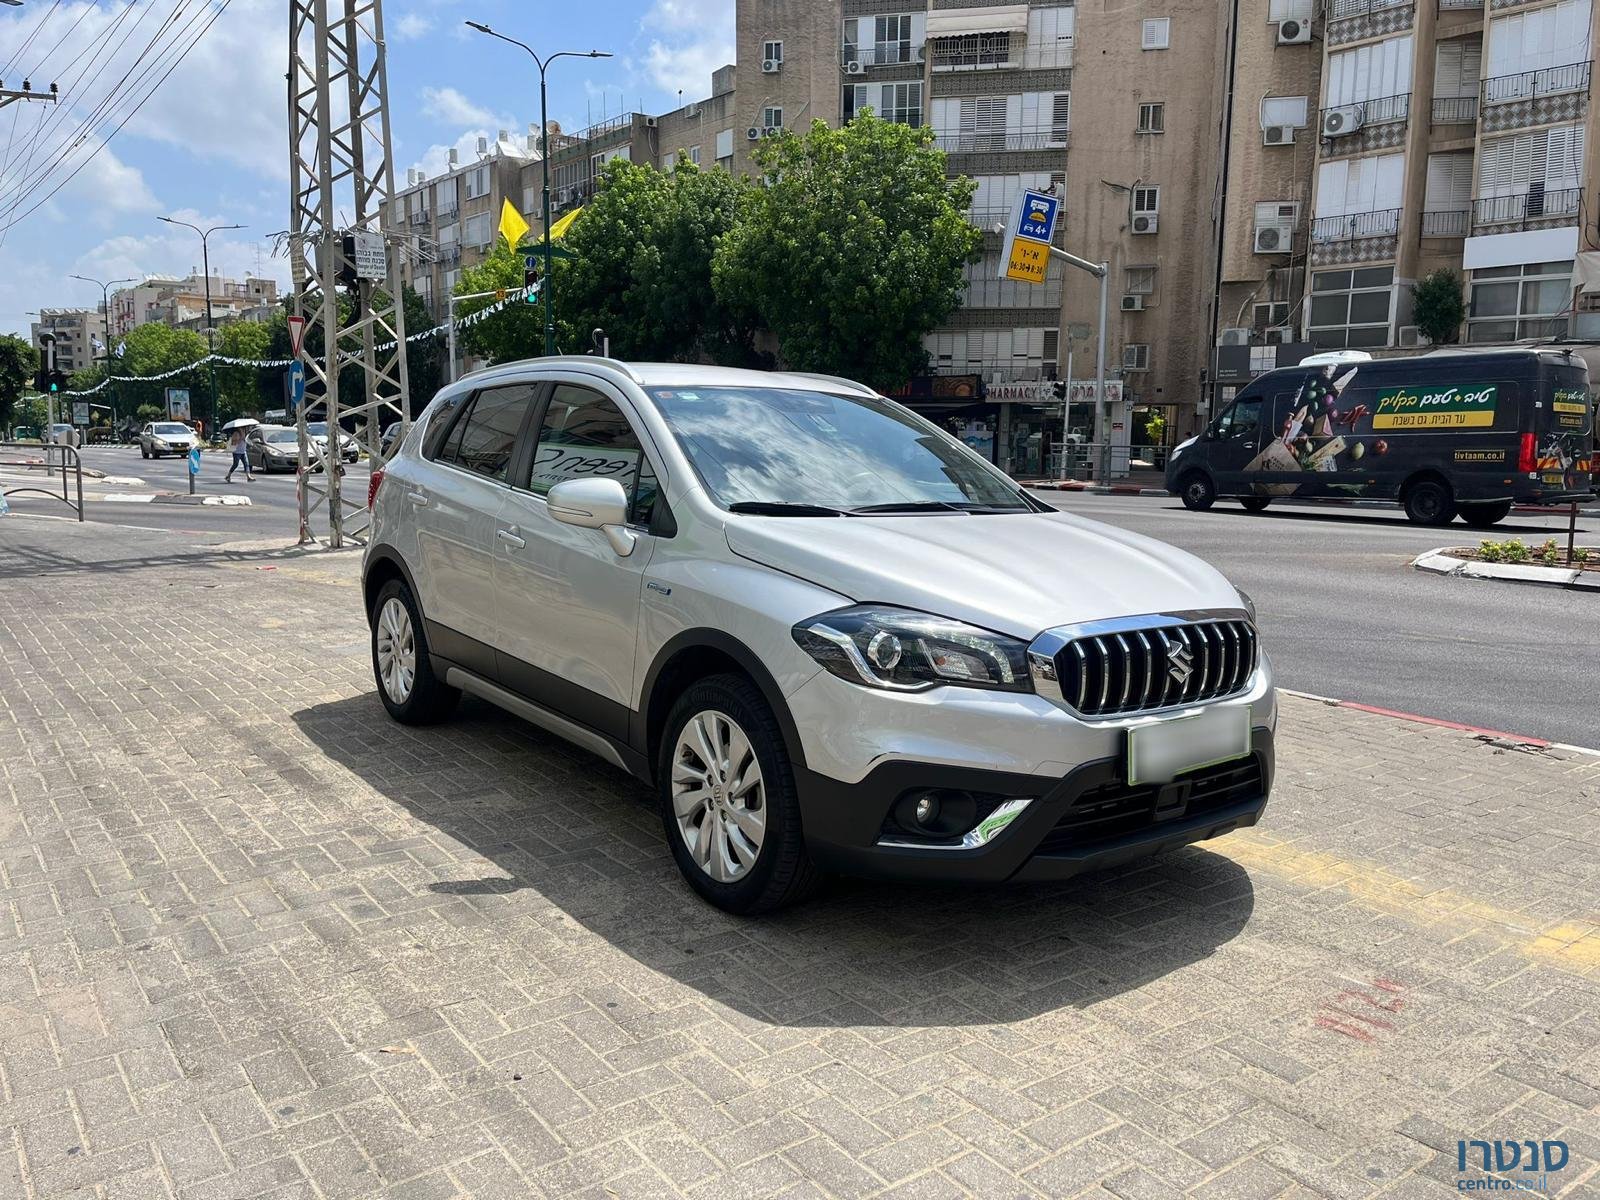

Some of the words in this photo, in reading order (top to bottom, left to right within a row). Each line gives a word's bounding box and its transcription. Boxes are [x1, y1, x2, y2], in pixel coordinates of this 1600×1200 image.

[1035, 225, 1047, 235] 4+
[986, 386, 1037, 399] PHARMACY
[1419, 388, 1458, 408] טעם
[1464, 387, 1496, 403] טיב
[1376, 390, 1418, 413] בקליק
[1391, 415, 1415, 426] בשבת
[1417, 415, 1428, 425] גם
[1454, 414, 1466, 424] עד
[1454, 451, 1505, 460] tivtaam.co.il
